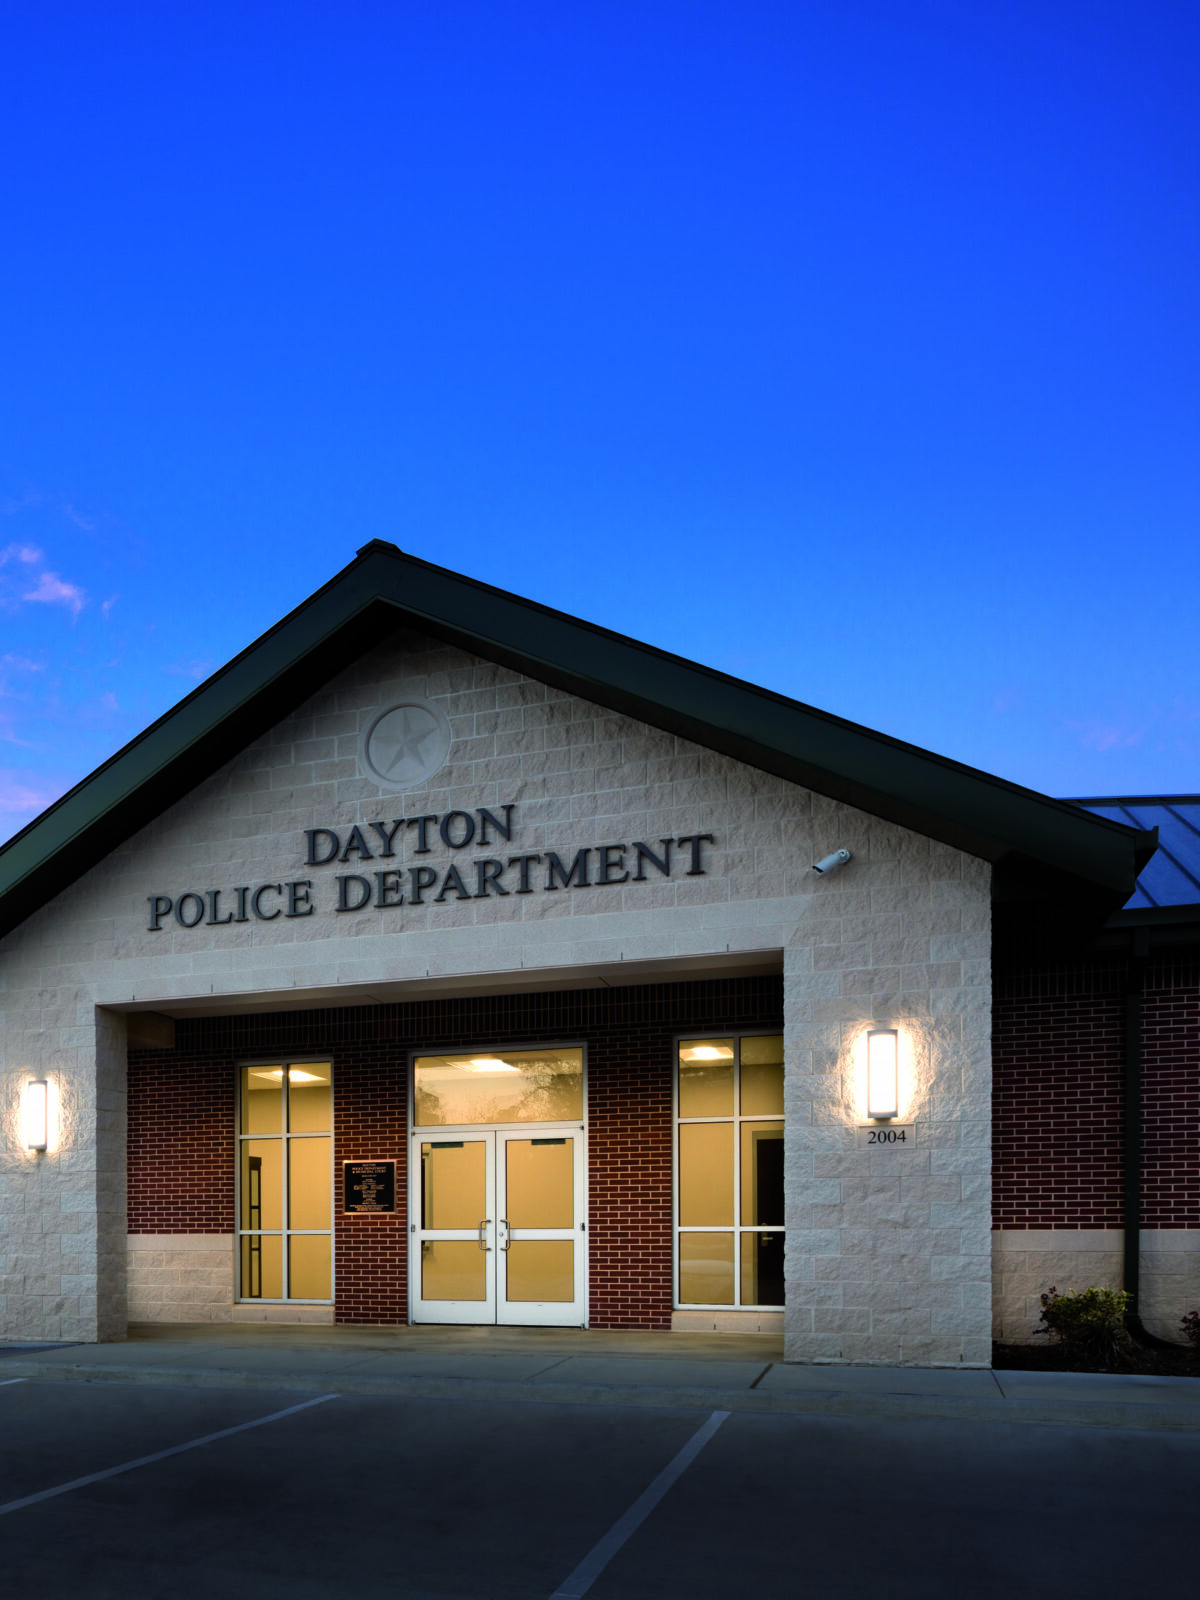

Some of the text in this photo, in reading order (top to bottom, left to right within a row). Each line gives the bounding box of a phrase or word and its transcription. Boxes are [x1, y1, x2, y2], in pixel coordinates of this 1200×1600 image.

[303, 804, 517, 867] DAYTON
[146, 833, 714, 932] POLICE DEPARTMENT
[867, 1130, 907, 1144] 2004
